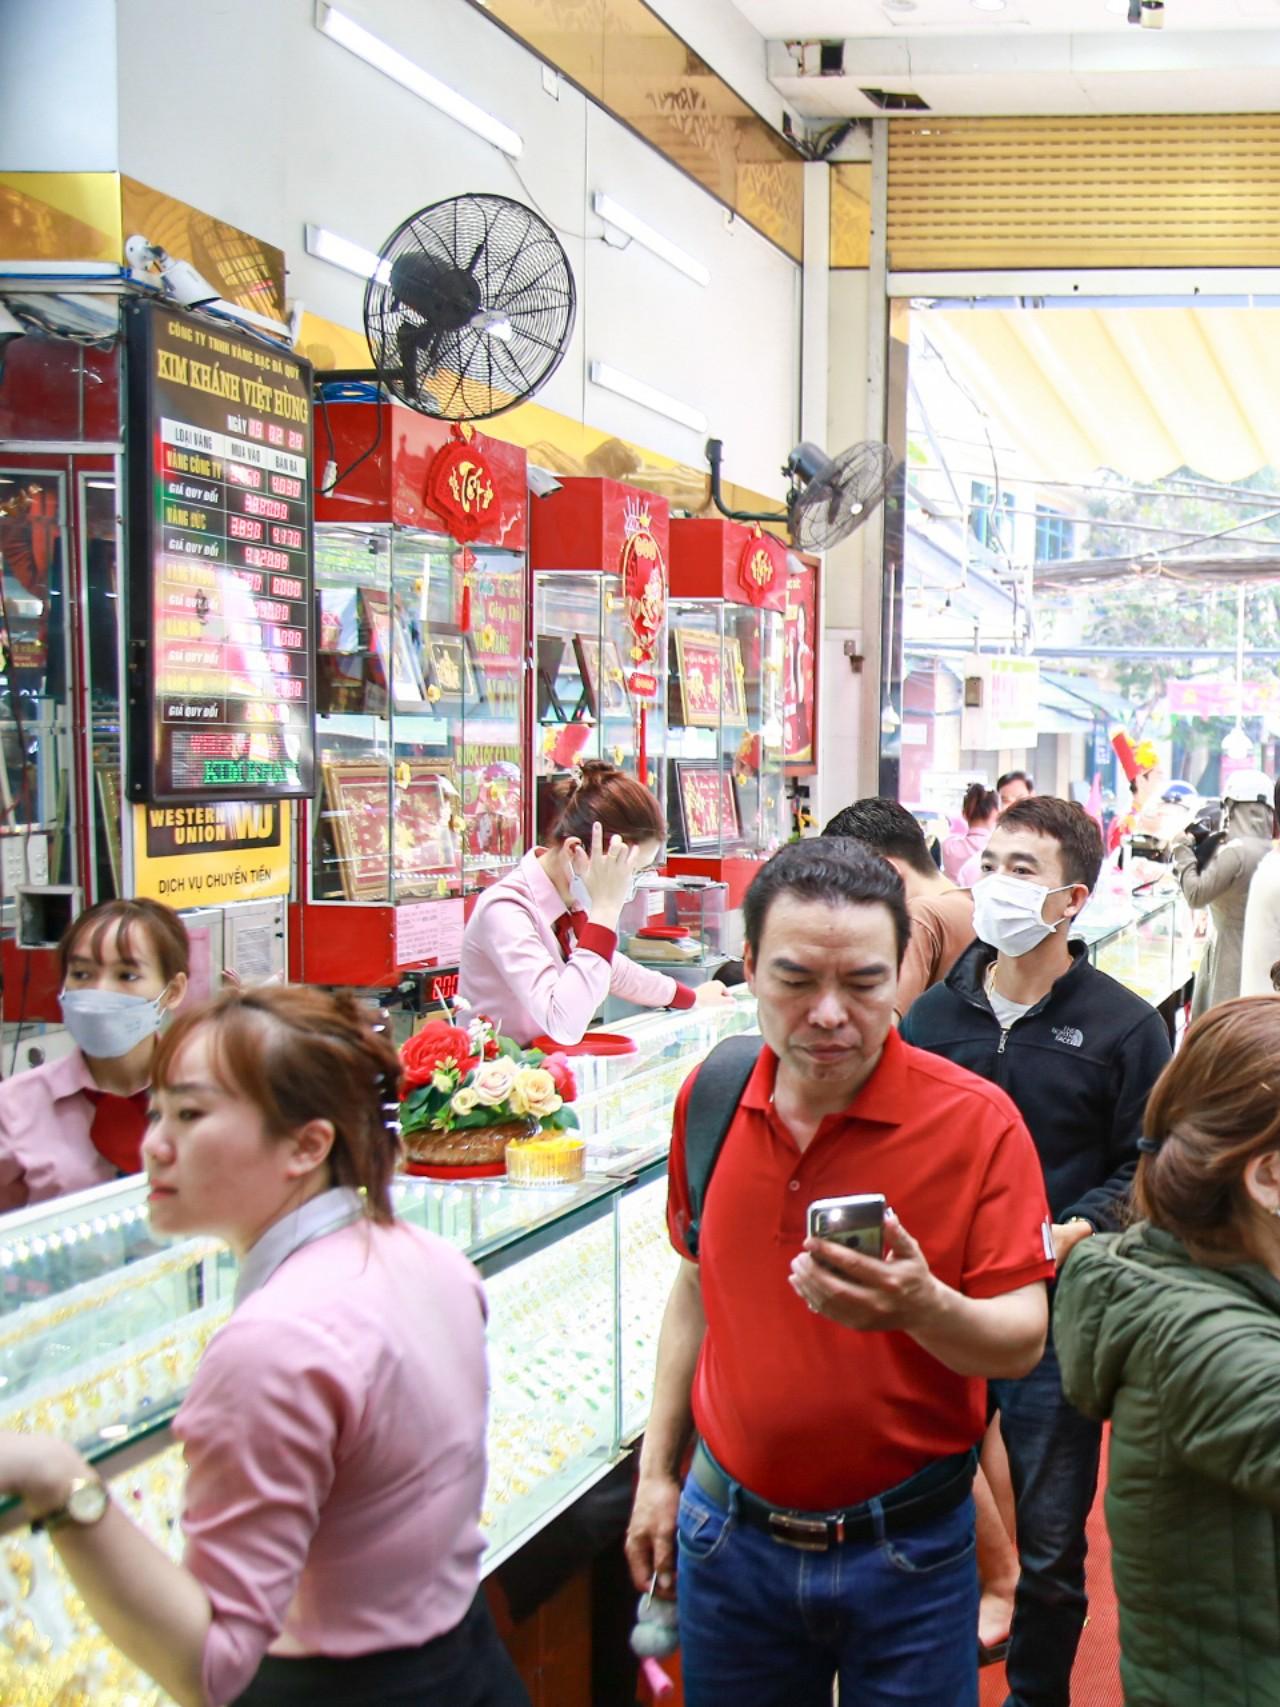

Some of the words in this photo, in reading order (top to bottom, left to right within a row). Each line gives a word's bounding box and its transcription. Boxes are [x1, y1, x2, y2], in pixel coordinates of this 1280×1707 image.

[168, 321, 193, 343] CÔNG
[195, 332, 206, 347] TY
[157, 349, 188, 386] KIM
[190, 361, 241, 403] KHÁNH
[242, 376, 273, 414] VIỆT
[273, 385, 309, 424] HÙNG
[168, 482, 184, 496] GIÁ
[185, 486, 203, 500] QUY
[168, 538, 184, 551] GIÁ
[185, 541, 203, 554] QUY
[203, 541, 219, 557] ĐỔI
[168, 703, 184, 717] GIÁ
[185, 705, 203, 718] QUY
[203, 702, 219, 718] ĐỔI
[150, 806, 226, 828] WESTERN
[174, 824, 226, 845] UNION
[159, 878, 185, 897] DỊCH
[188, 875, 203, 893] VỤ
